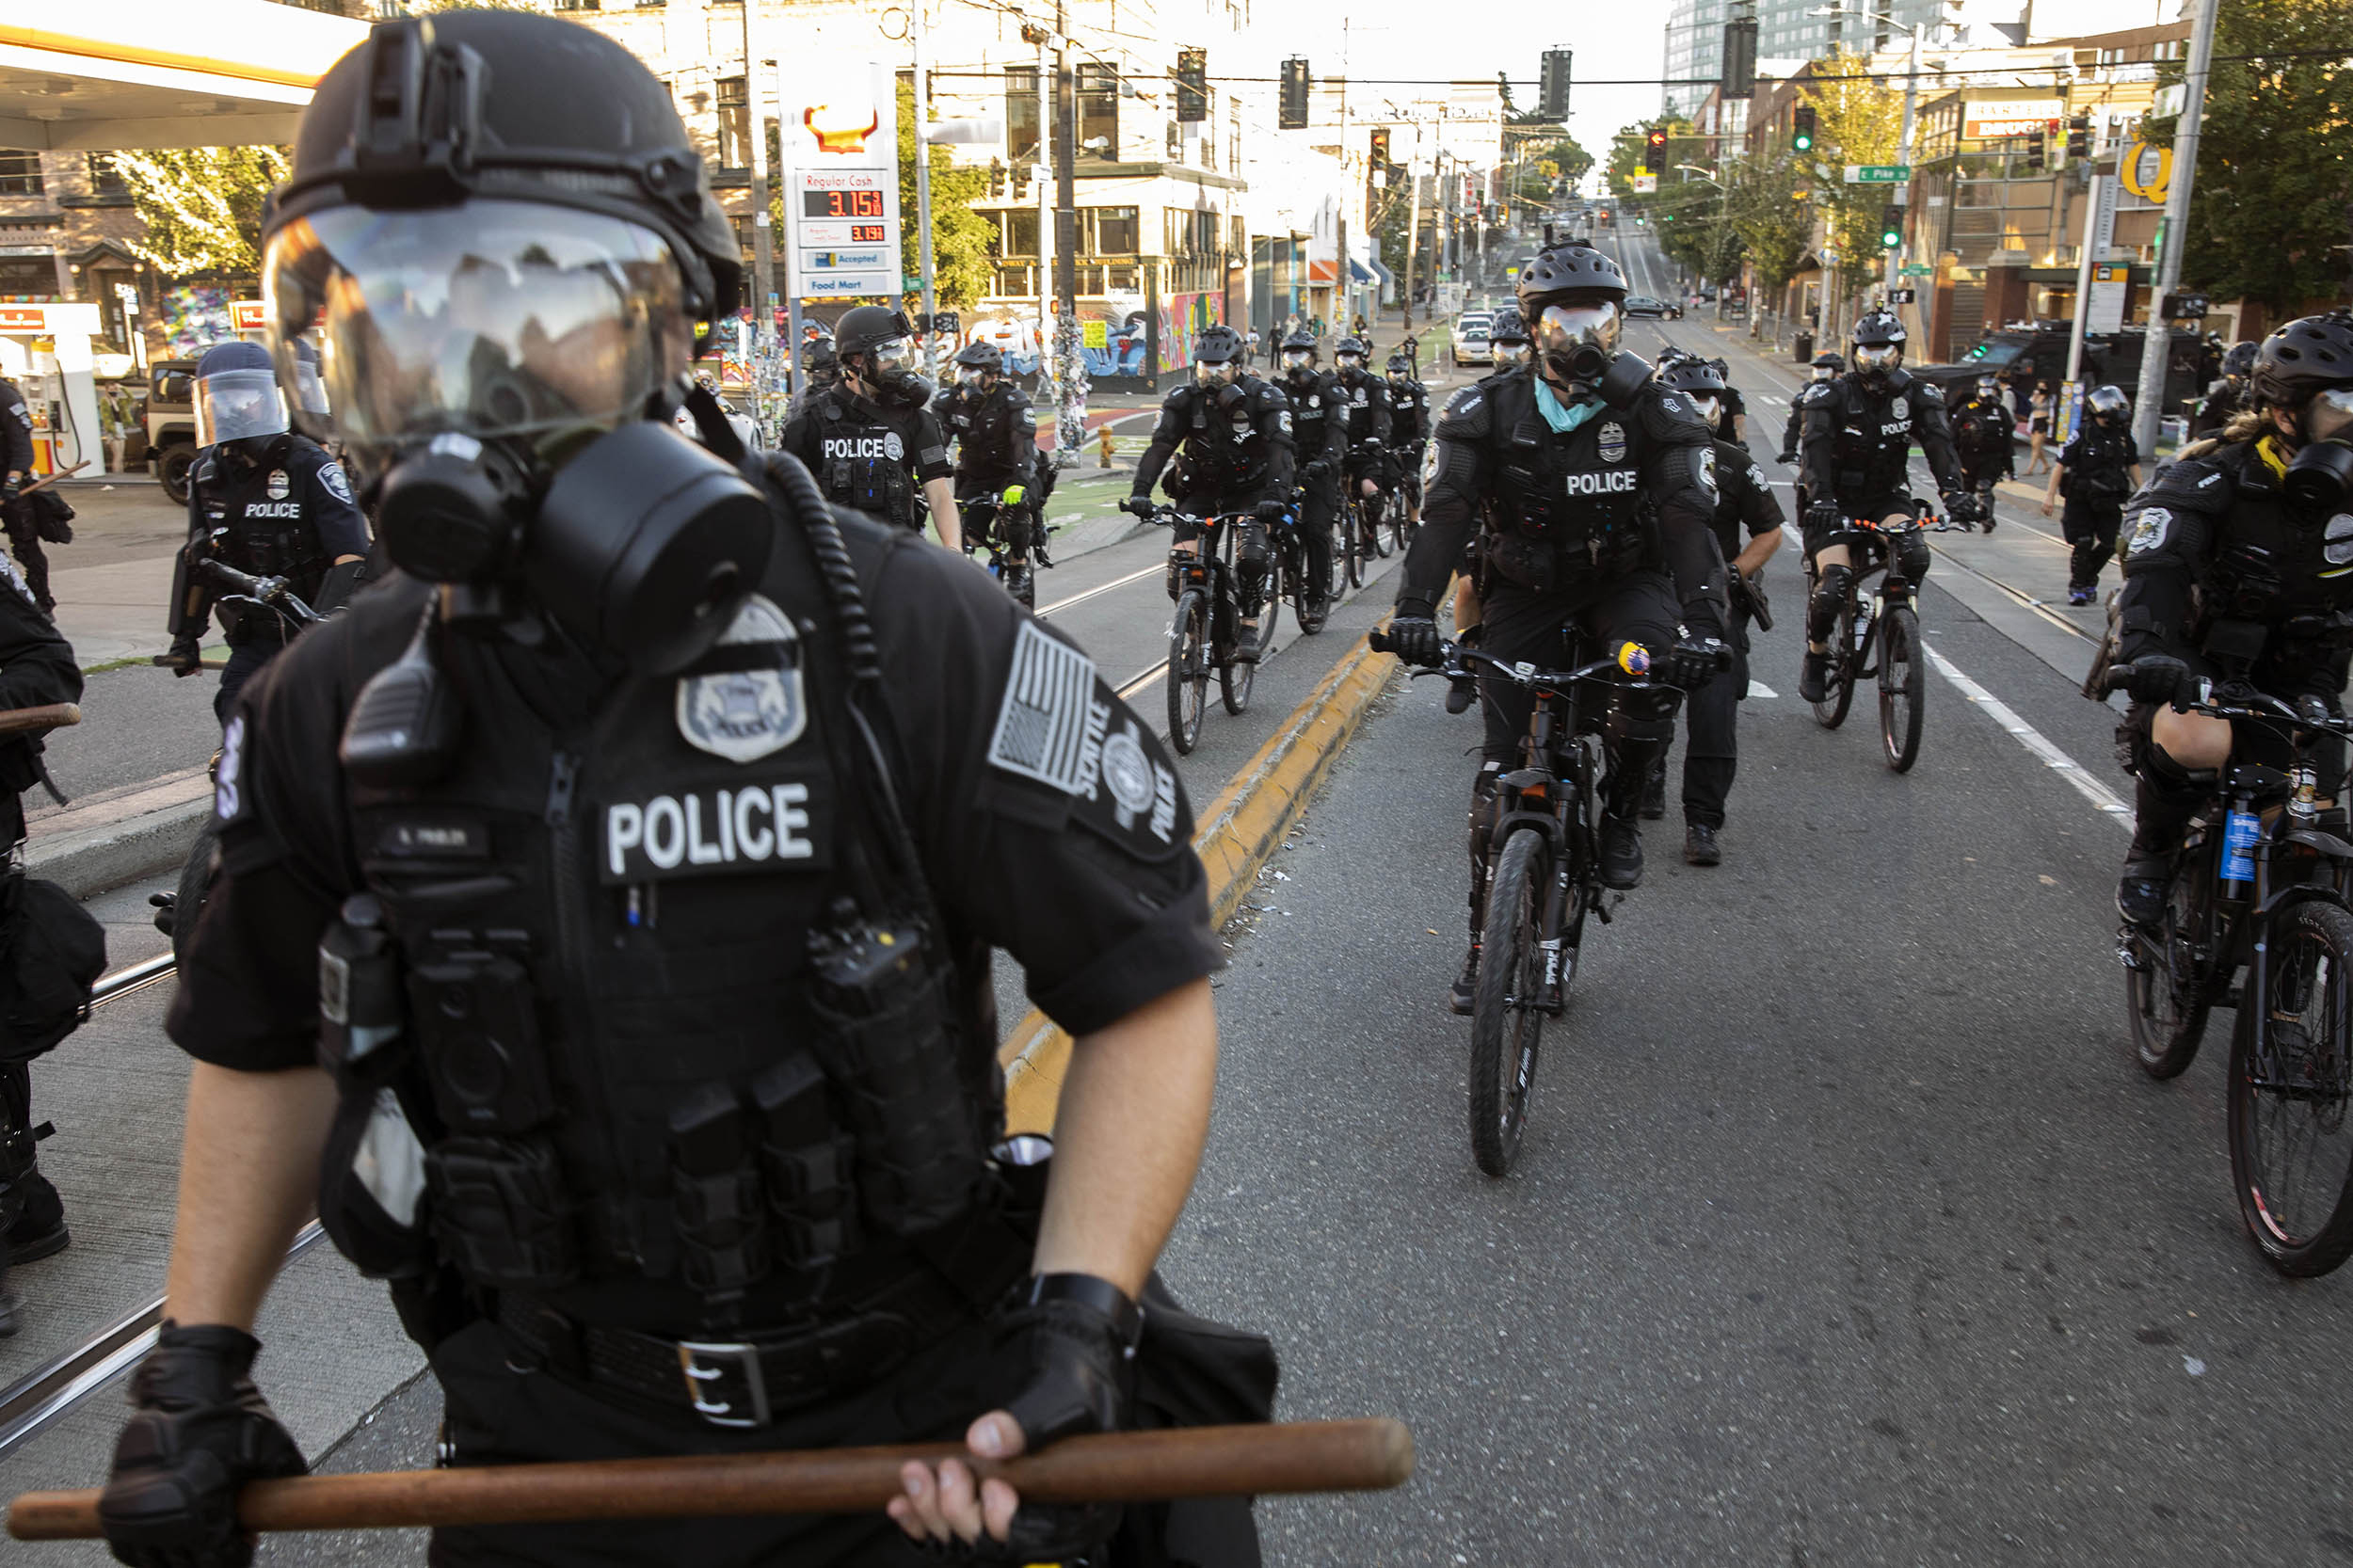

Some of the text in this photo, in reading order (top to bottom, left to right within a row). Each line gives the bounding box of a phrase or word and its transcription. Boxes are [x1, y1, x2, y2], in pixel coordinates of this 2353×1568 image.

[1873, 169, 1895, 179] Pike
[807, 175, 872, 189] Regular Cash
[838, 254, 877, 264] Accepted
[811, 280, 861, 290] Food Mart
[1396, 401, 1415, 410] POLICE
[824, 439, 885, 458] POLICE
[1567, 471, 1637, 495] POLICE
[245, 504, 301, 519] POLICE
[1080, 698, 1112, 801] SEATTLE
[1148, 760, 1178, 844] POLICE
[606, 783, 813, 875] POLICE
